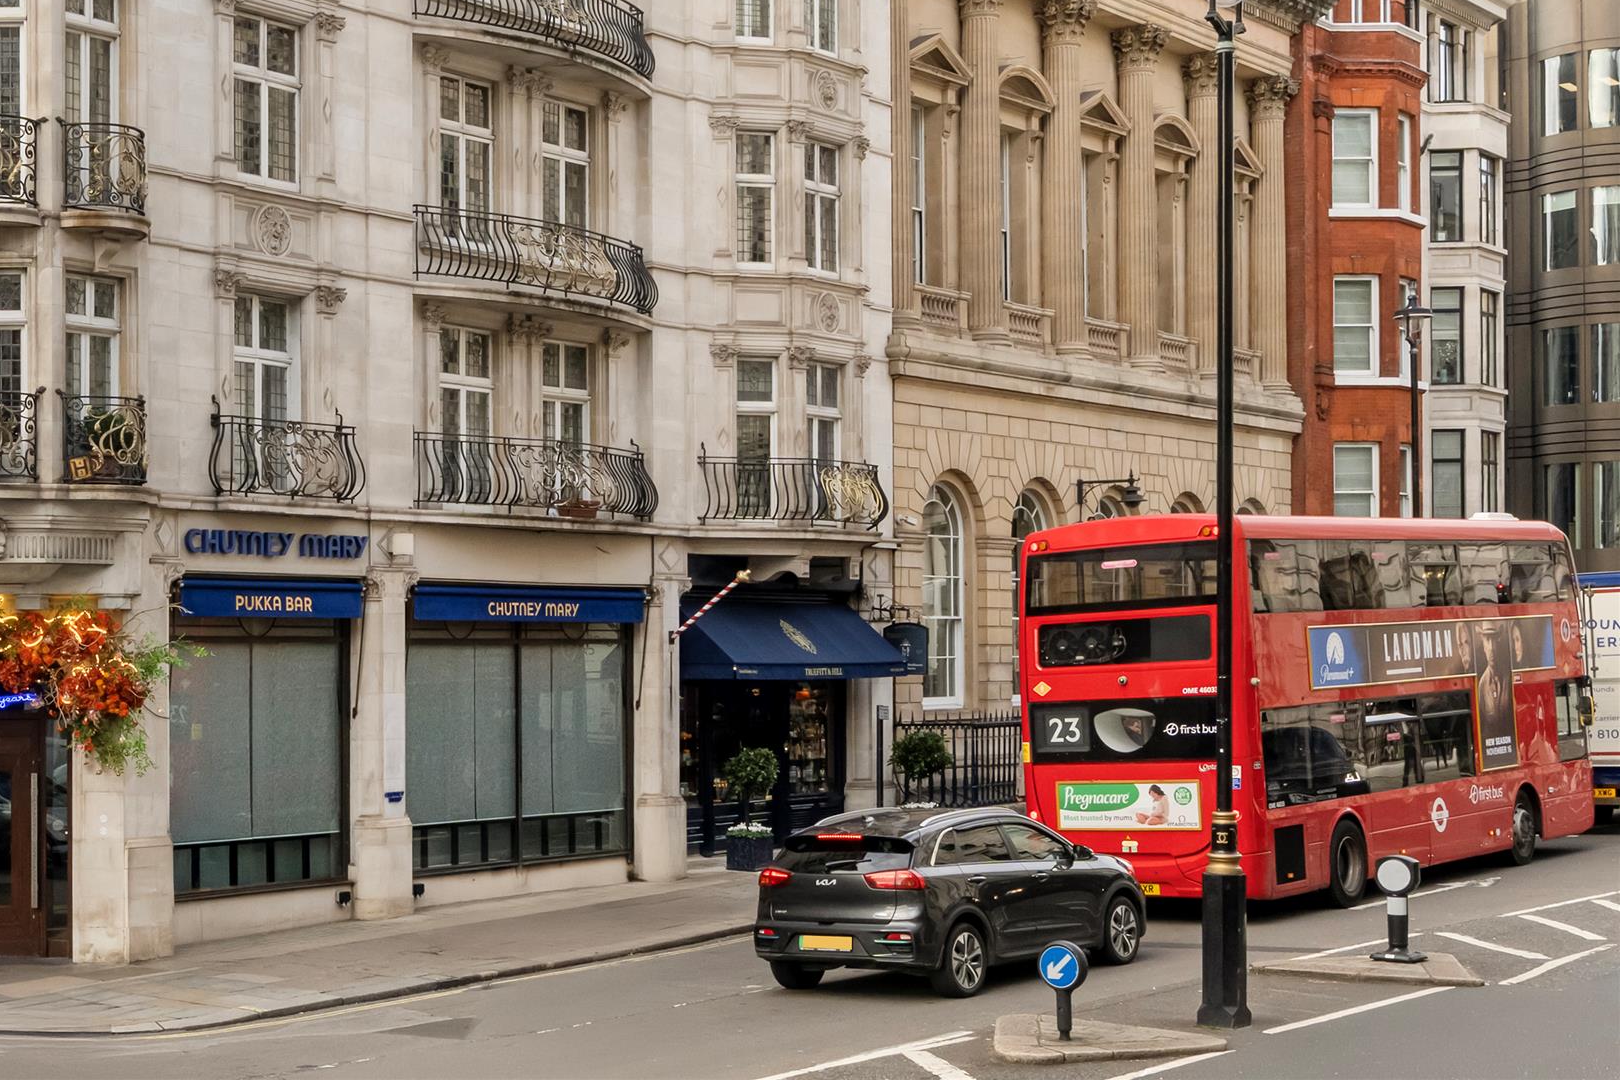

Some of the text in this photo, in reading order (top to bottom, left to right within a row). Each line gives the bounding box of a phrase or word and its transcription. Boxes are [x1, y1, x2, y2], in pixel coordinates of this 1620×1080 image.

[184, 529, 368, 560] CHUTNEY MARY
[235, 595, 312, 612] PUKKA BAR
[488, 602, 579, 617] CHUTNEY MARY
[1383, 630, 1453, 662] LANDMAN
[1048, 717, 1081, 743] 23
[1180, 724, 1200, 734] first
[1063, 786, 1130, 810] Pregnacare
[1104, 814, 1112, 822] by
[815, 878, 837, 887] KIA
